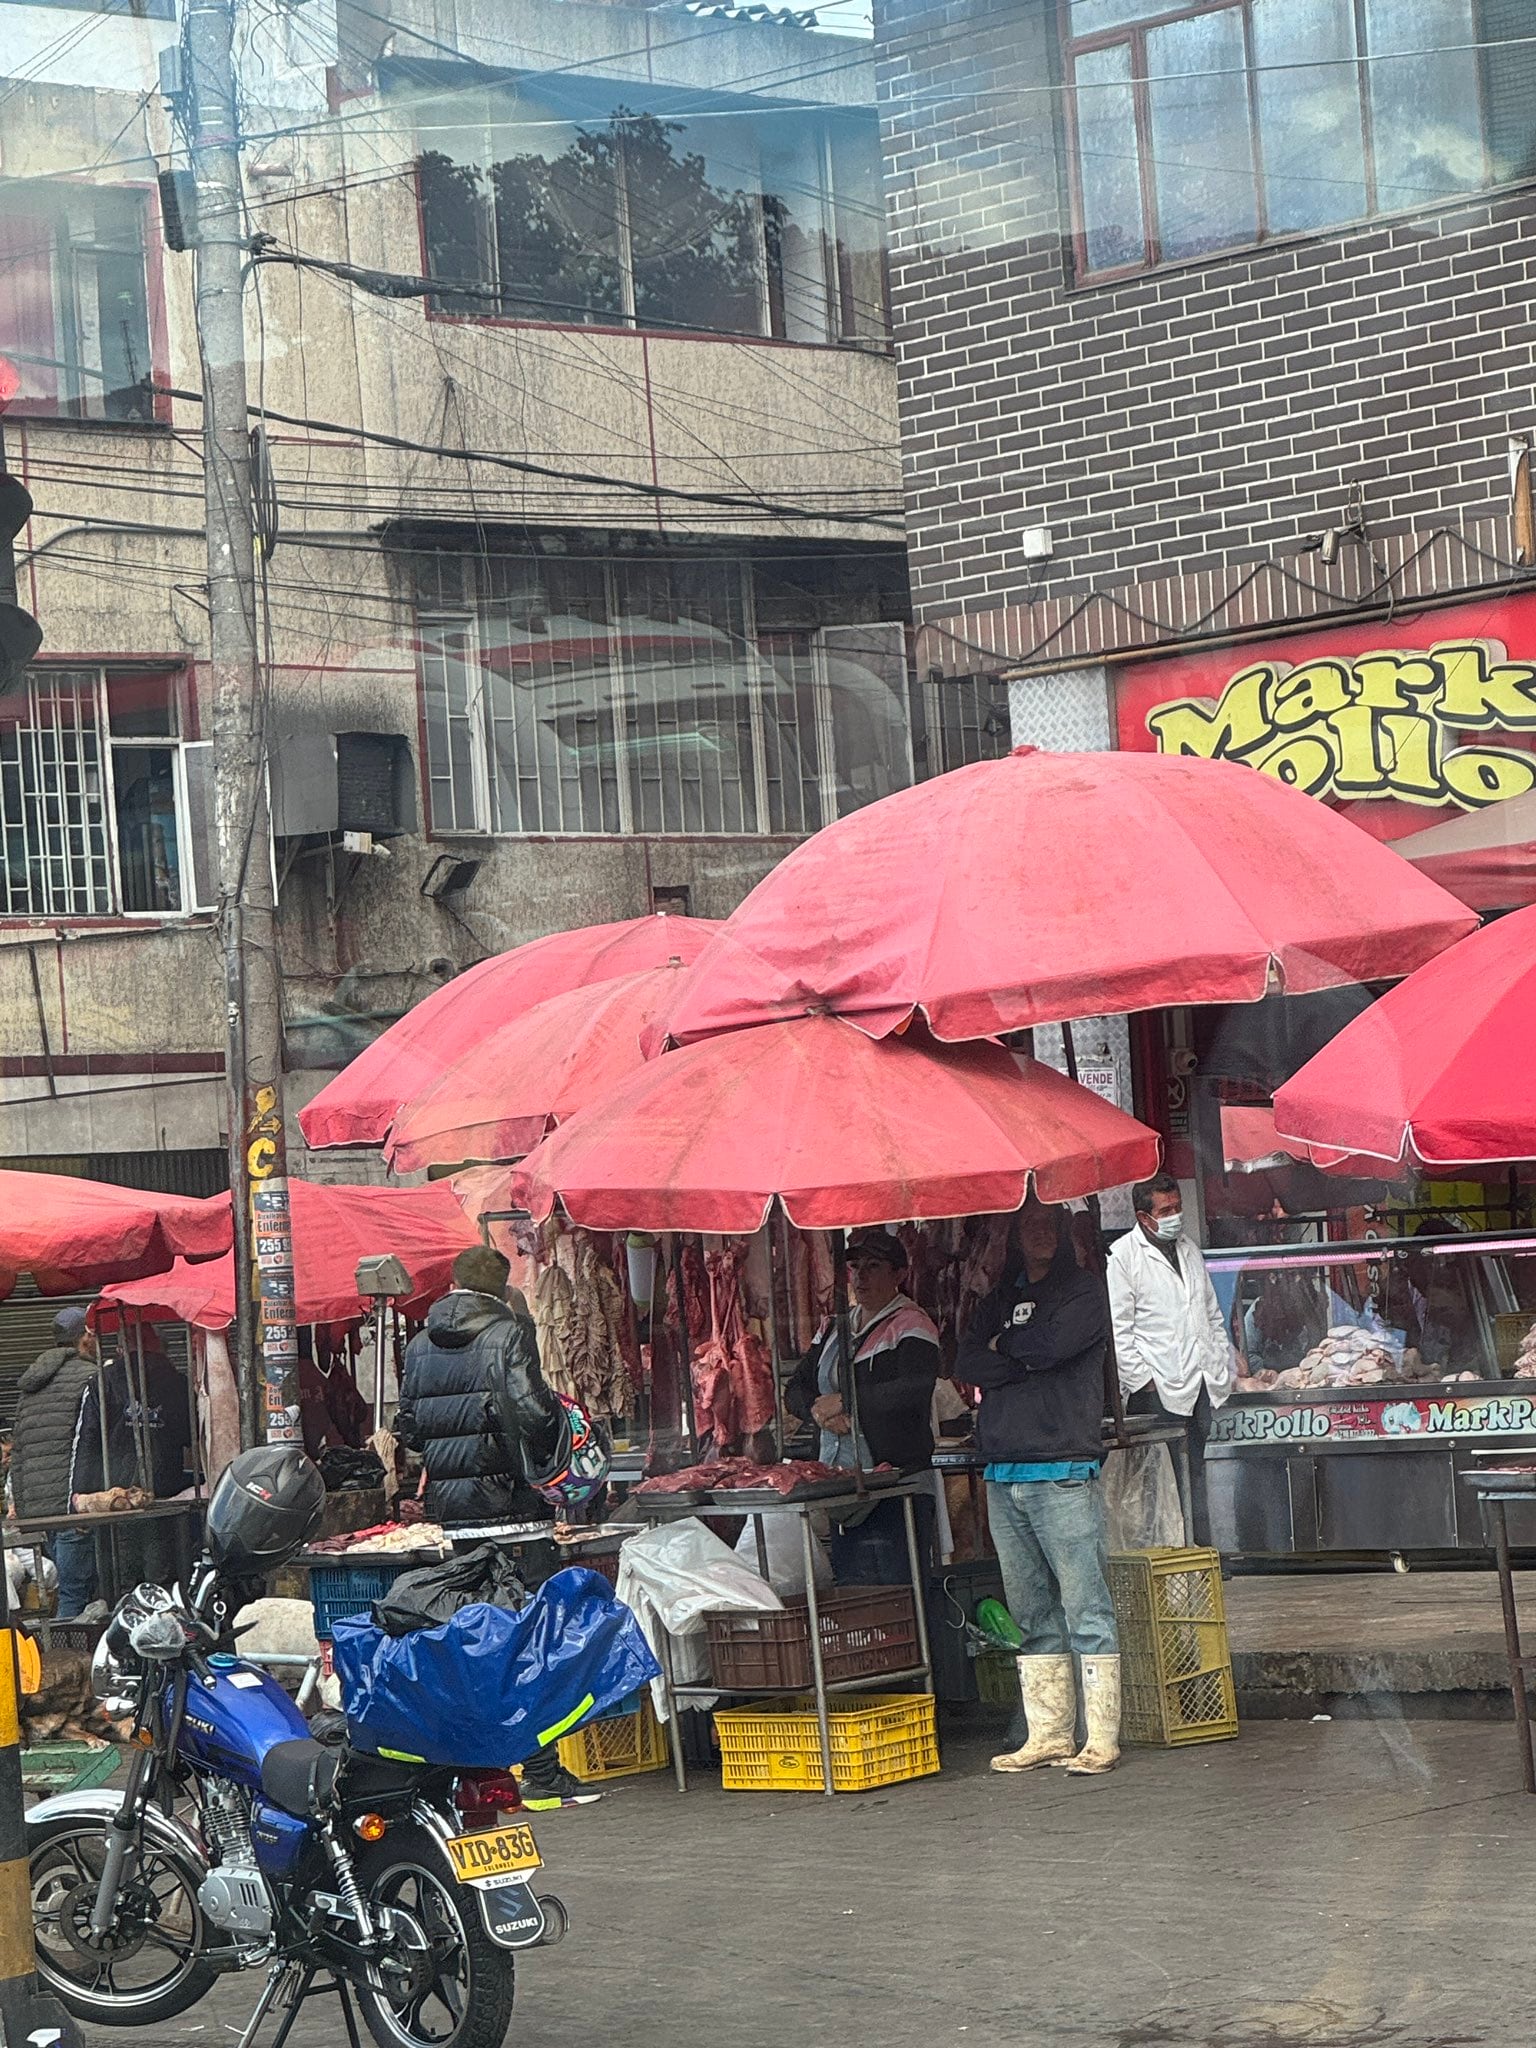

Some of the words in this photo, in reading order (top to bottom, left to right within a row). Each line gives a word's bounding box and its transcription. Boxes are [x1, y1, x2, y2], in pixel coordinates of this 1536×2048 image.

[1148, 641, 1536, 760] Mark
[1252, 705, 1536, 809] ollo
[1079, 1073, 1113, 1085] VENDE
[259, 1239, 281, 1254] 255
[266, 1326, 287, 1340] 255
[1206, 1408, 1331, 1442] arkPollo
[495, 1917, 539, 1934] SUZUKI
